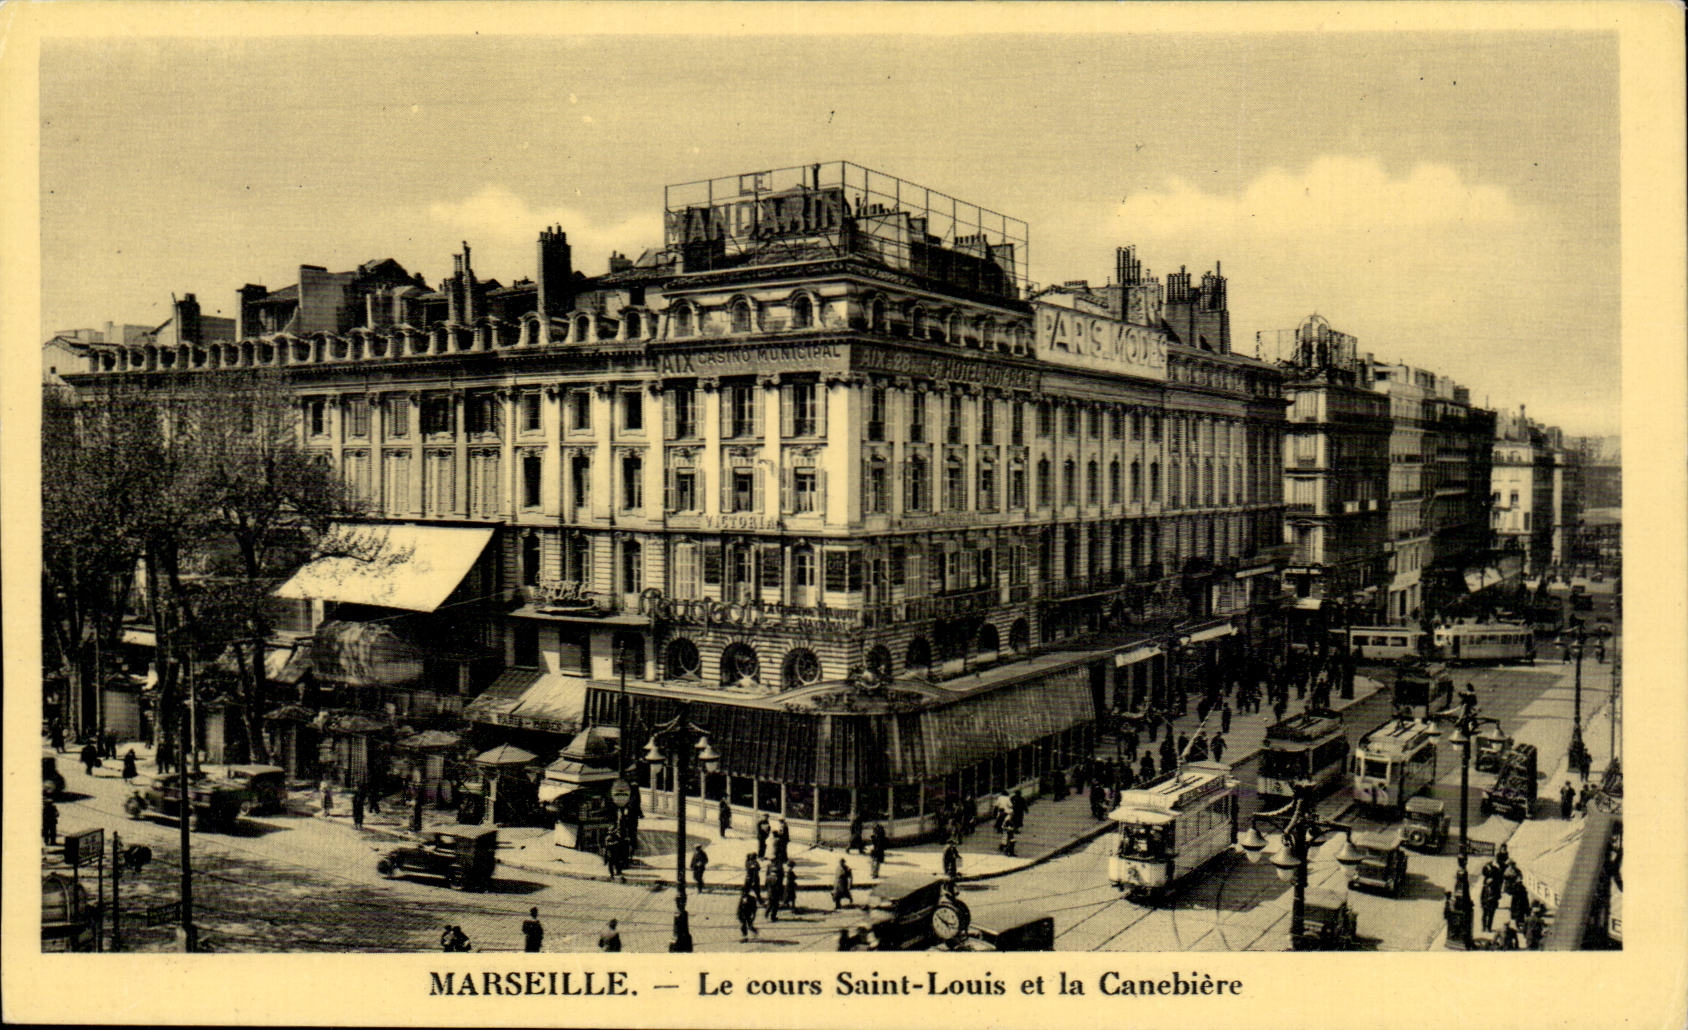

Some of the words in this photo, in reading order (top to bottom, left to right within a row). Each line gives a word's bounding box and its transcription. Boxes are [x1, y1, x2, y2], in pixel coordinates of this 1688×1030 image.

[738, 170, 773, 196] LE
[664, 188, 844, 248] MANDARIN
[661, 352, 696, 375] AIX
[699, 348, 750, 365] CASINO
[756, 344, 842, 363] MUNICIPAL
[859, 348, 886, 369] AIX
[705, 514, 777, 530] VICTORIA
